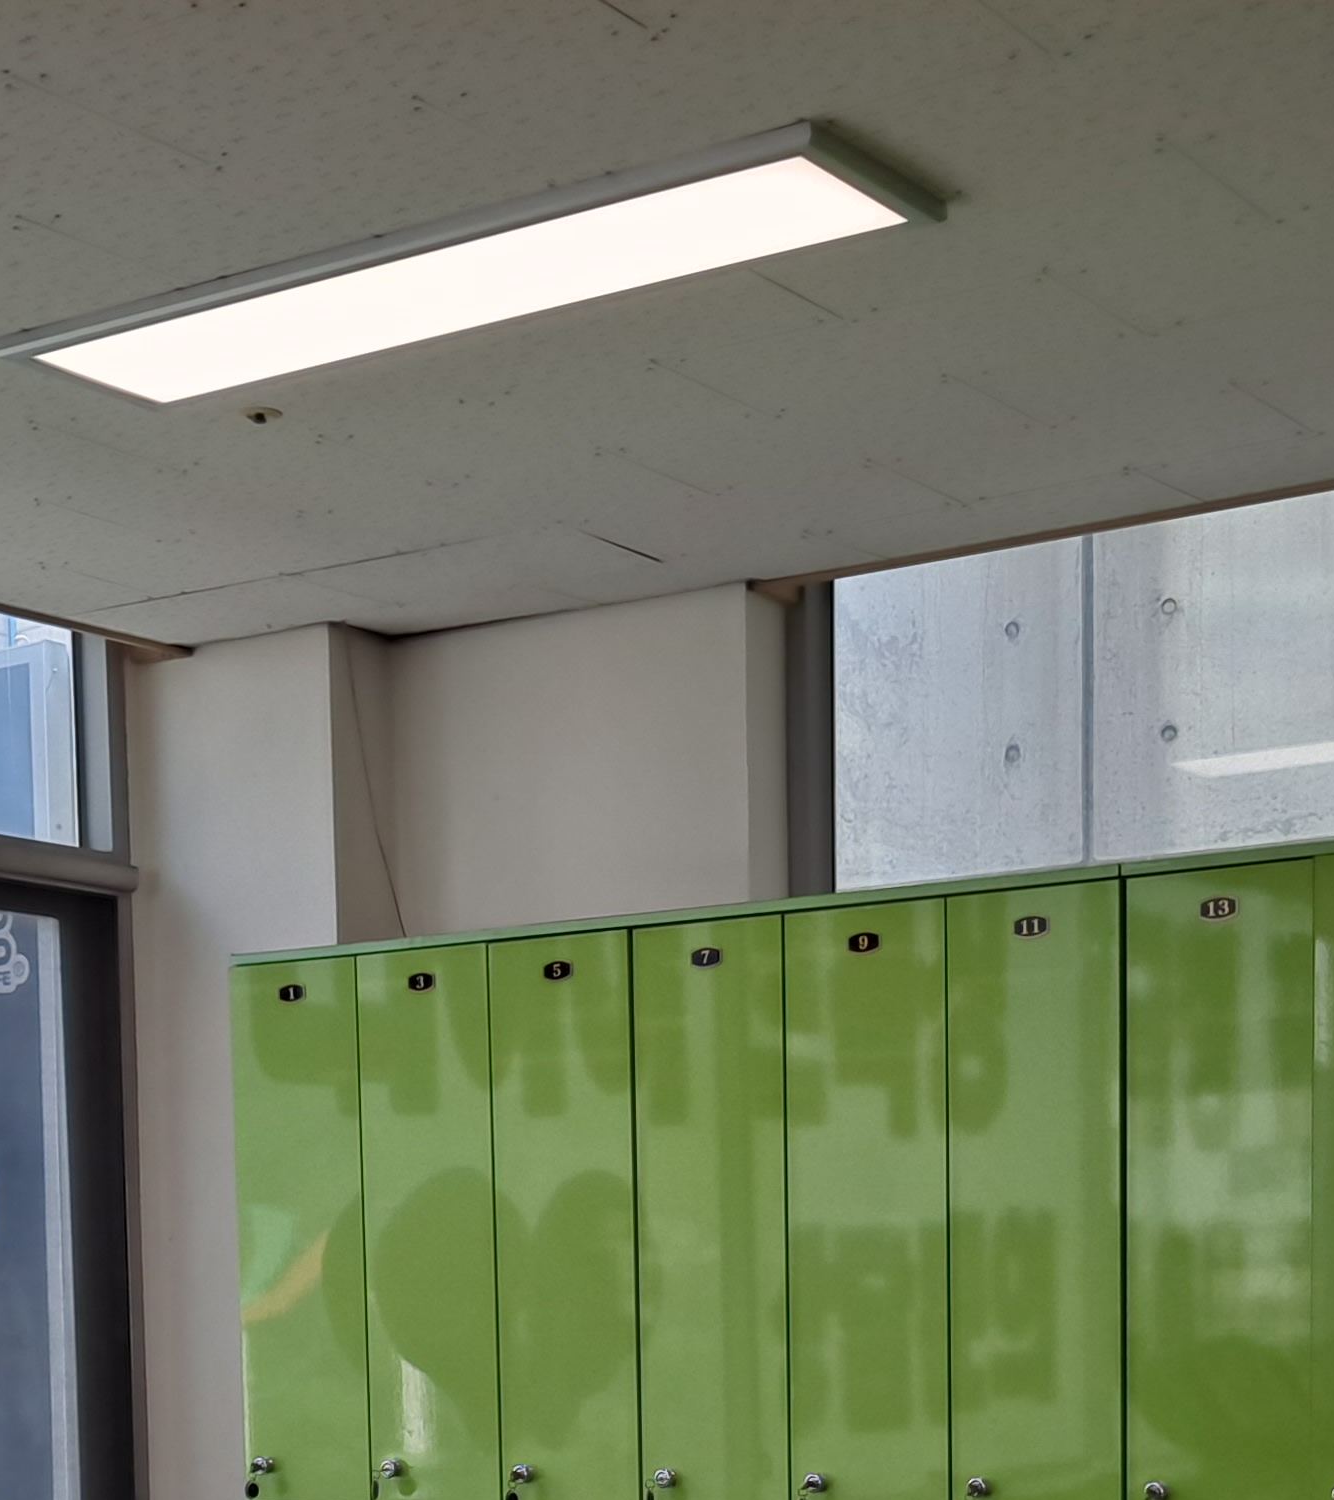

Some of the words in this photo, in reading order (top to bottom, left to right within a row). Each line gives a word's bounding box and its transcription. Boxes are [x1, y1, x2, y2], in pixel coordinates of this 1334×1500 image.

[1207, 899, 1229, 916] 13
[1020, 919, 1040, 934] 11
[859, 936, 868, 949] 9
[701, 950, 710, 964] 7
[553, 964, 561, 977] 5
[417, 976, 424, 988] 3
[288, 987, 295, 999] 1
